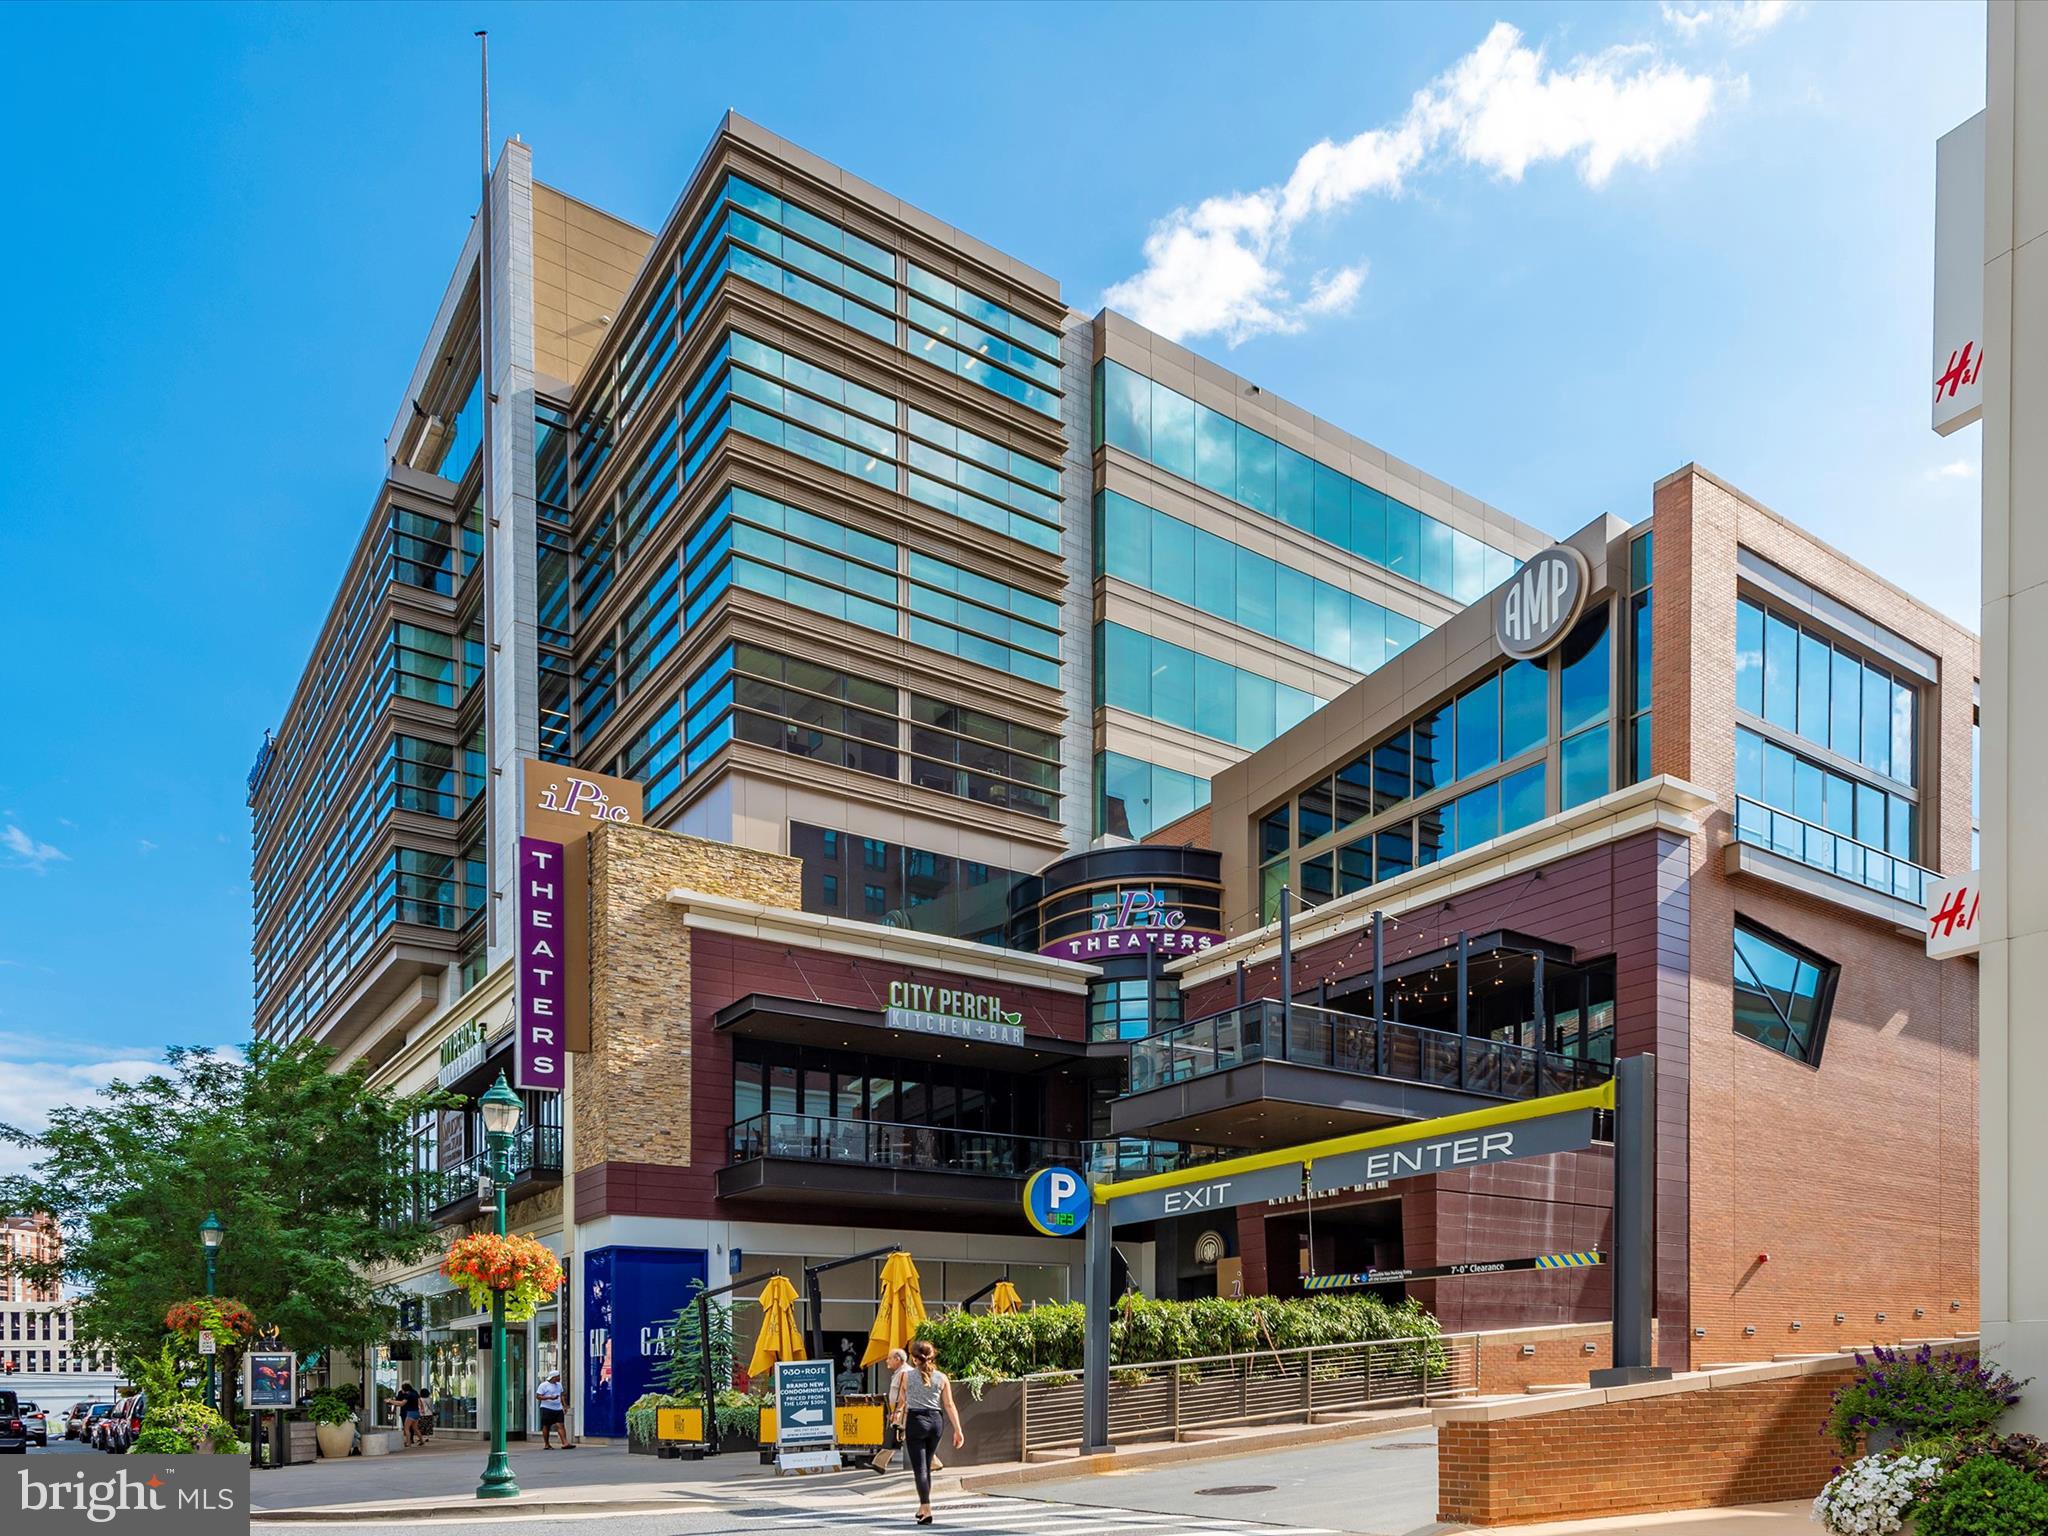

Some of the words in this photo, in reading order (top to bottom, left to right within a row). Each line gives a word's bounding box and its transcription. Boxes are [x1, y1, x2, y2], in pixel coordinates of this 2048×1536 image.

[1505, 559, 1569, 641] AMP
[538, 777, 631, 822] iPic
[1091, 890, 1187, 933] iPic
[531, 851, 555, 1074] THEATERS
[1069, 932, 1212, 955] THEATERS
[889, 980, 934, 1012] CITY
[938, 988, 1001, 1022] PERCH
[891, 1010, 971, 1036] KITCHEN
[990, 1025, 1020, 1044] BAR
[1367, 1131, 1514, 1179] ENTER
[1051, 1173, 1076, 1209] P
[1164, 1182, 1232, 1214] EXIT
[1470, 1263, 1505, 1273] Clearance
[780, 1387, 830, 1395] CONDOMINIUMS
